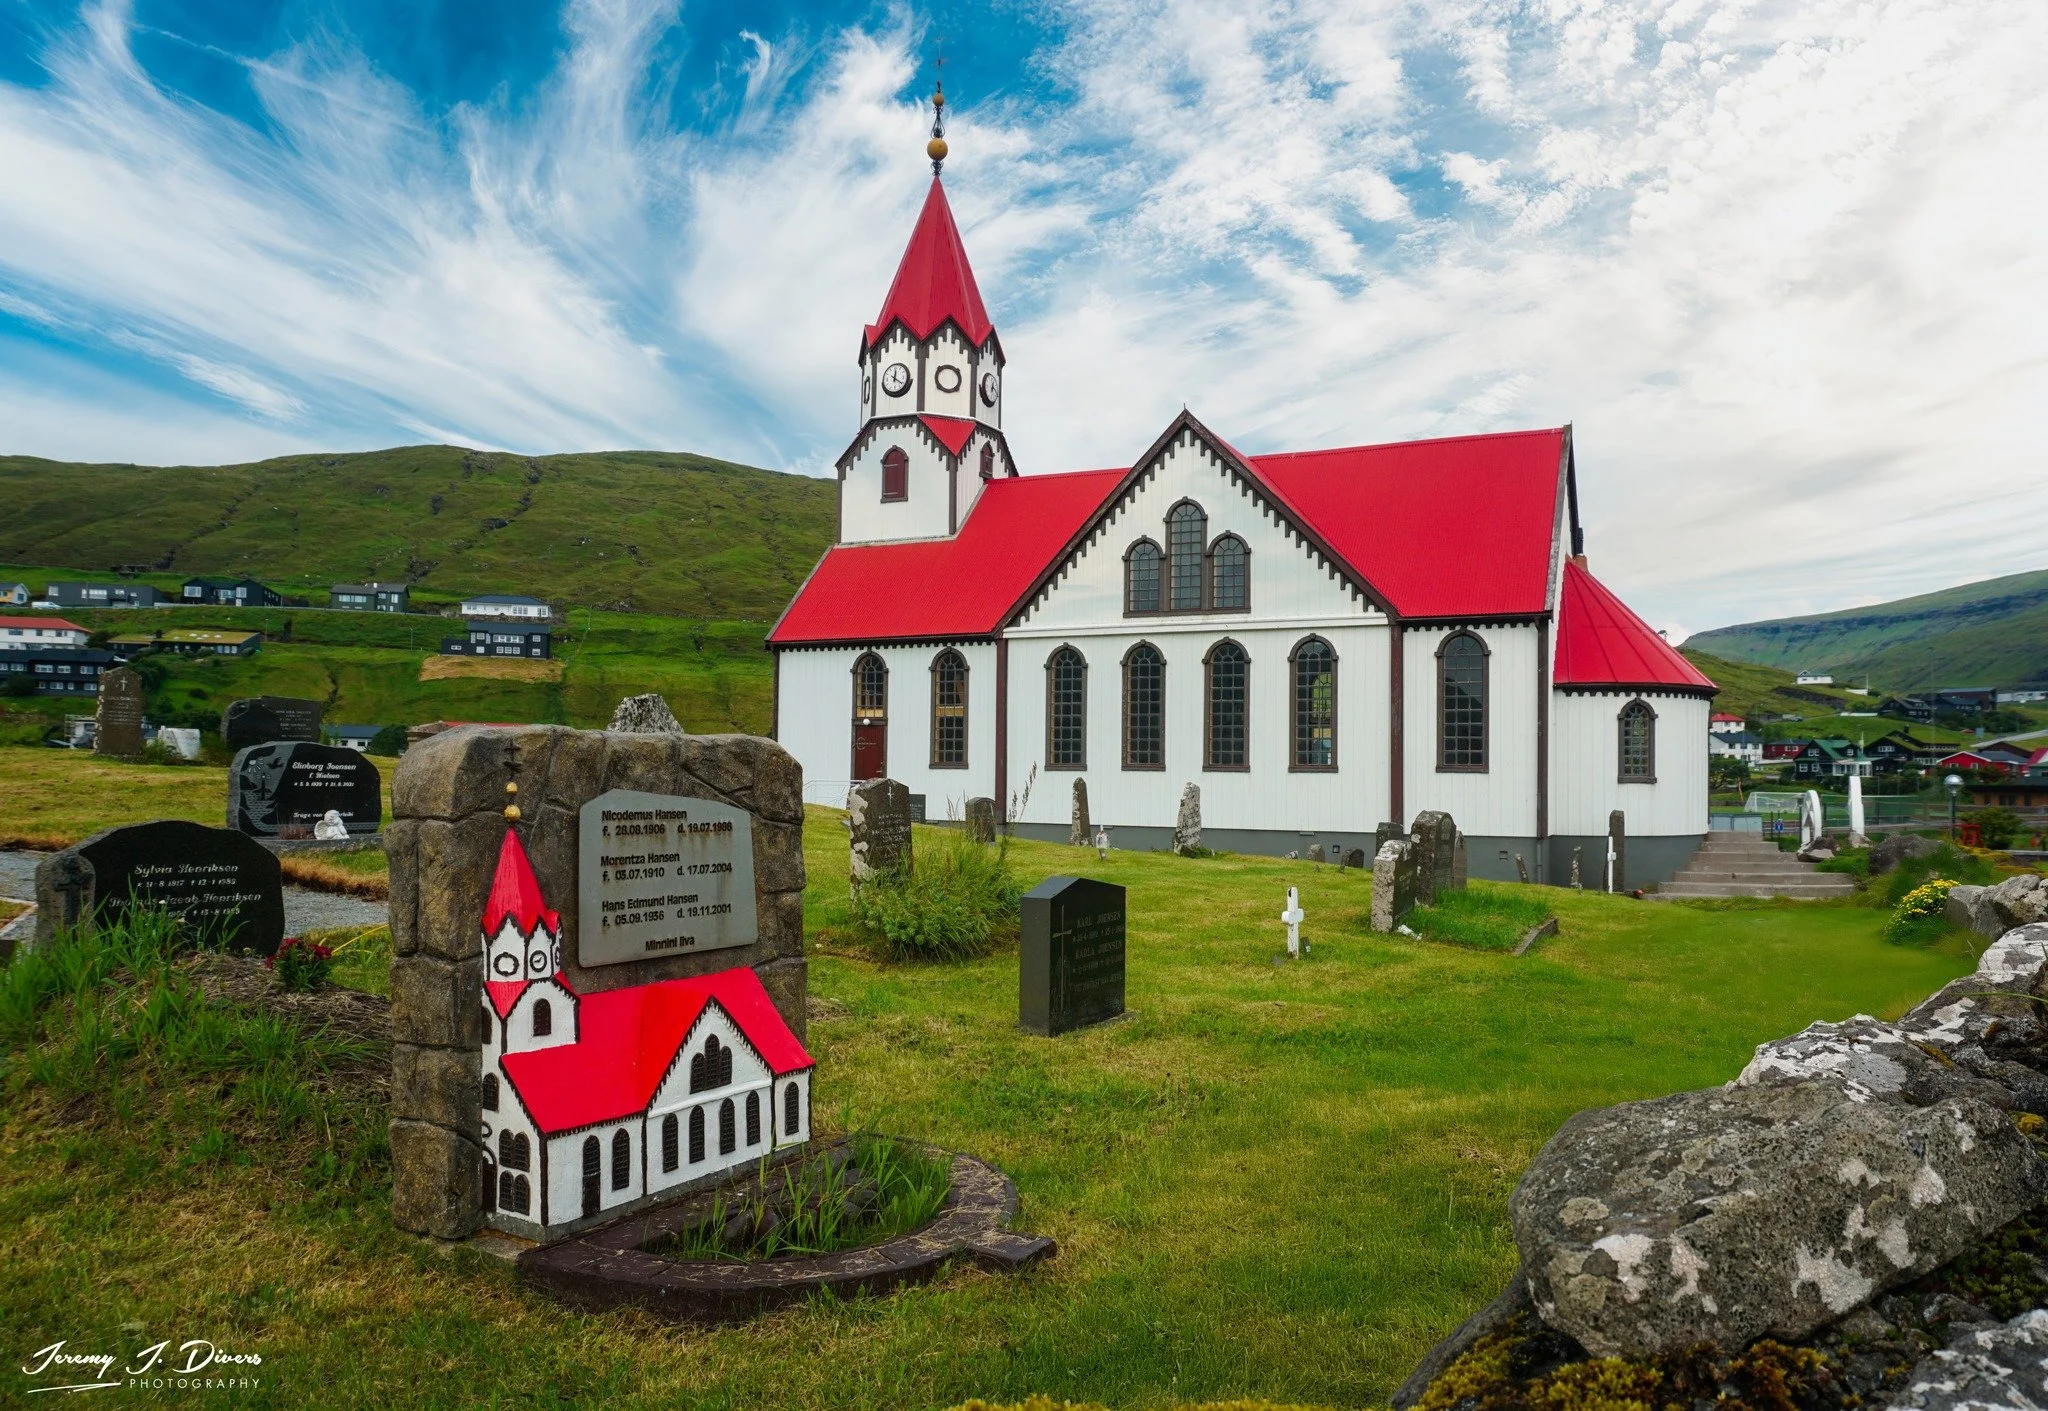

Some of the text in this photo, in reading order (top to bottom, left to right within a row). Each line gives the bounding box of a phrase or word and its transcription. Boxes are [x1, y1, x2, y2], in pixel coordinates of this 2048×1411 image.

[601, 809, 688, 822] Nicodemus Hansen
[602, 826, 611, 837] f.
[615, 823, 666, 836] 28.08.1906
[677, 823, 686, 834] d.
[600, 852, 680, 867] Morentza Hansen
[134, 863, 239, 877] Sylvia Henriksen
[602, 863, 733, 882] f. 03.07.1910 d. 17.07.2004
[203, 891, 261, 903] Henriksen
[602, 894, 699, 913] Hans Edmund Hansen
[602, 904, 732, 927] f. 05.09.1936 d. 19.11.2001
